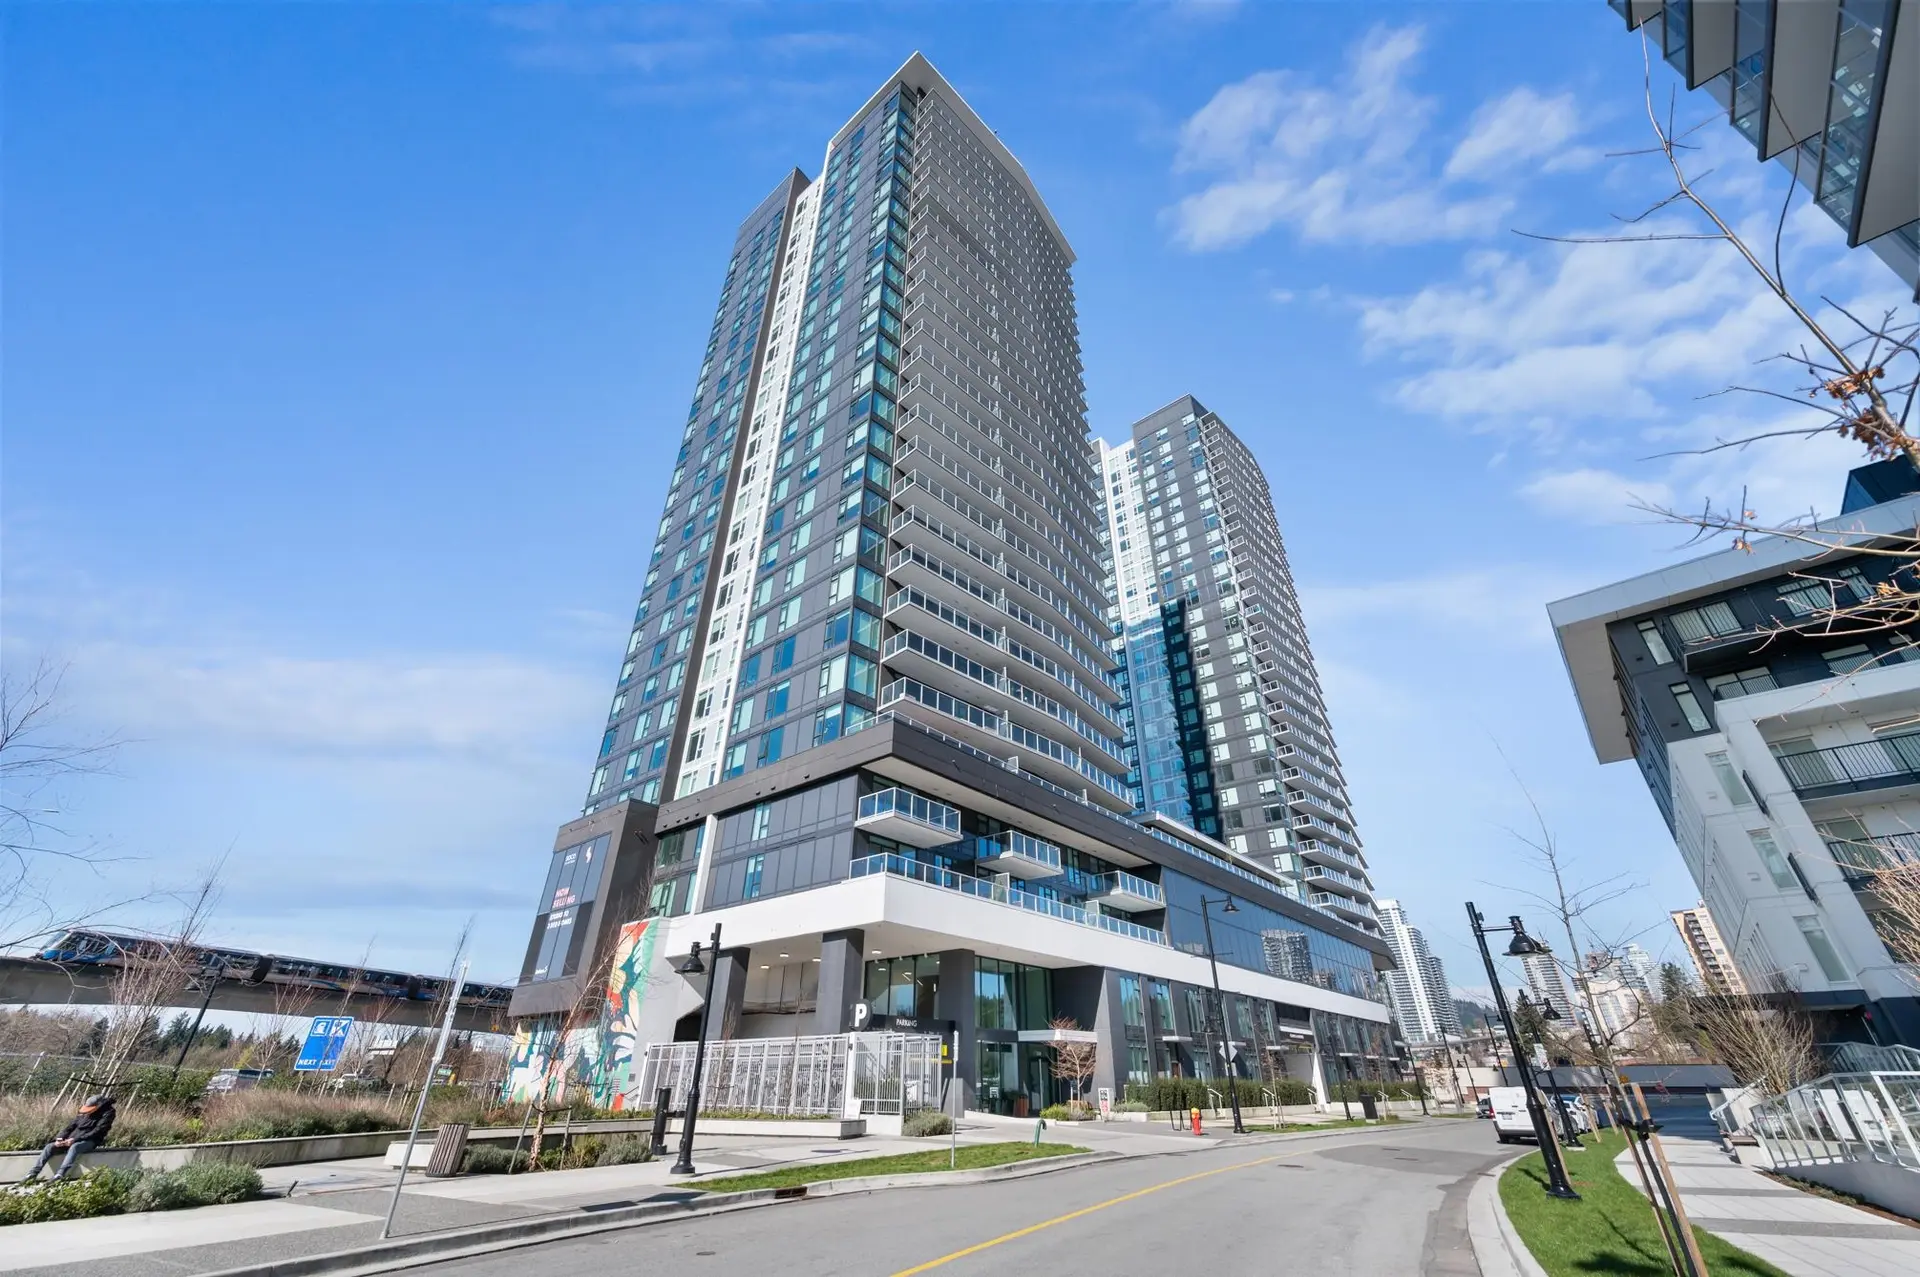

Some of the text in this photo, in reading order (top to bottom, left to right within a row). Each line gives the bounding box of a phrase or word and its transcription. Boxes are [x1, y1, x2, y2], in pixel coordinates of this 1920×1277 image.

[553, 894, 576, 908] SELLING
[854, 1003, 867, 1027] P
[896, 1018, 917, 1028] PARKING
